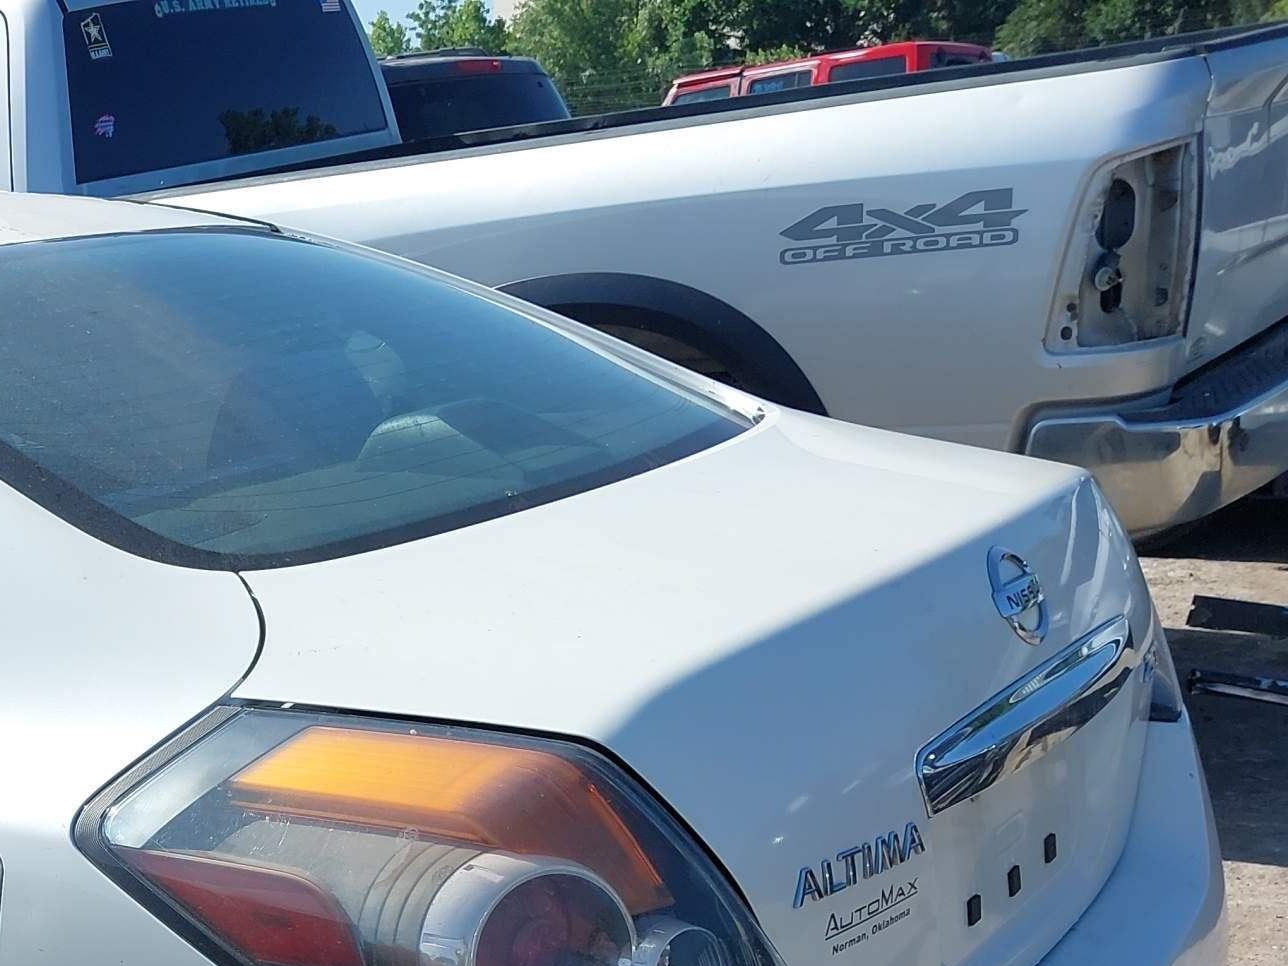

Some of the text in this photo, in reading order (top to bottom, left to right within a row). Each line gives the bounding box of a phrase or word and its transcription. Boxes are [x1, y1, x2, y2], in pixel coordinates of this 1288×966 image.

[783, 230, 1014, 262] OFF ROAD
[792, 821, 926, 910] ALTIMA
[831, 907, 911, 957] Norman, Oklahoma
